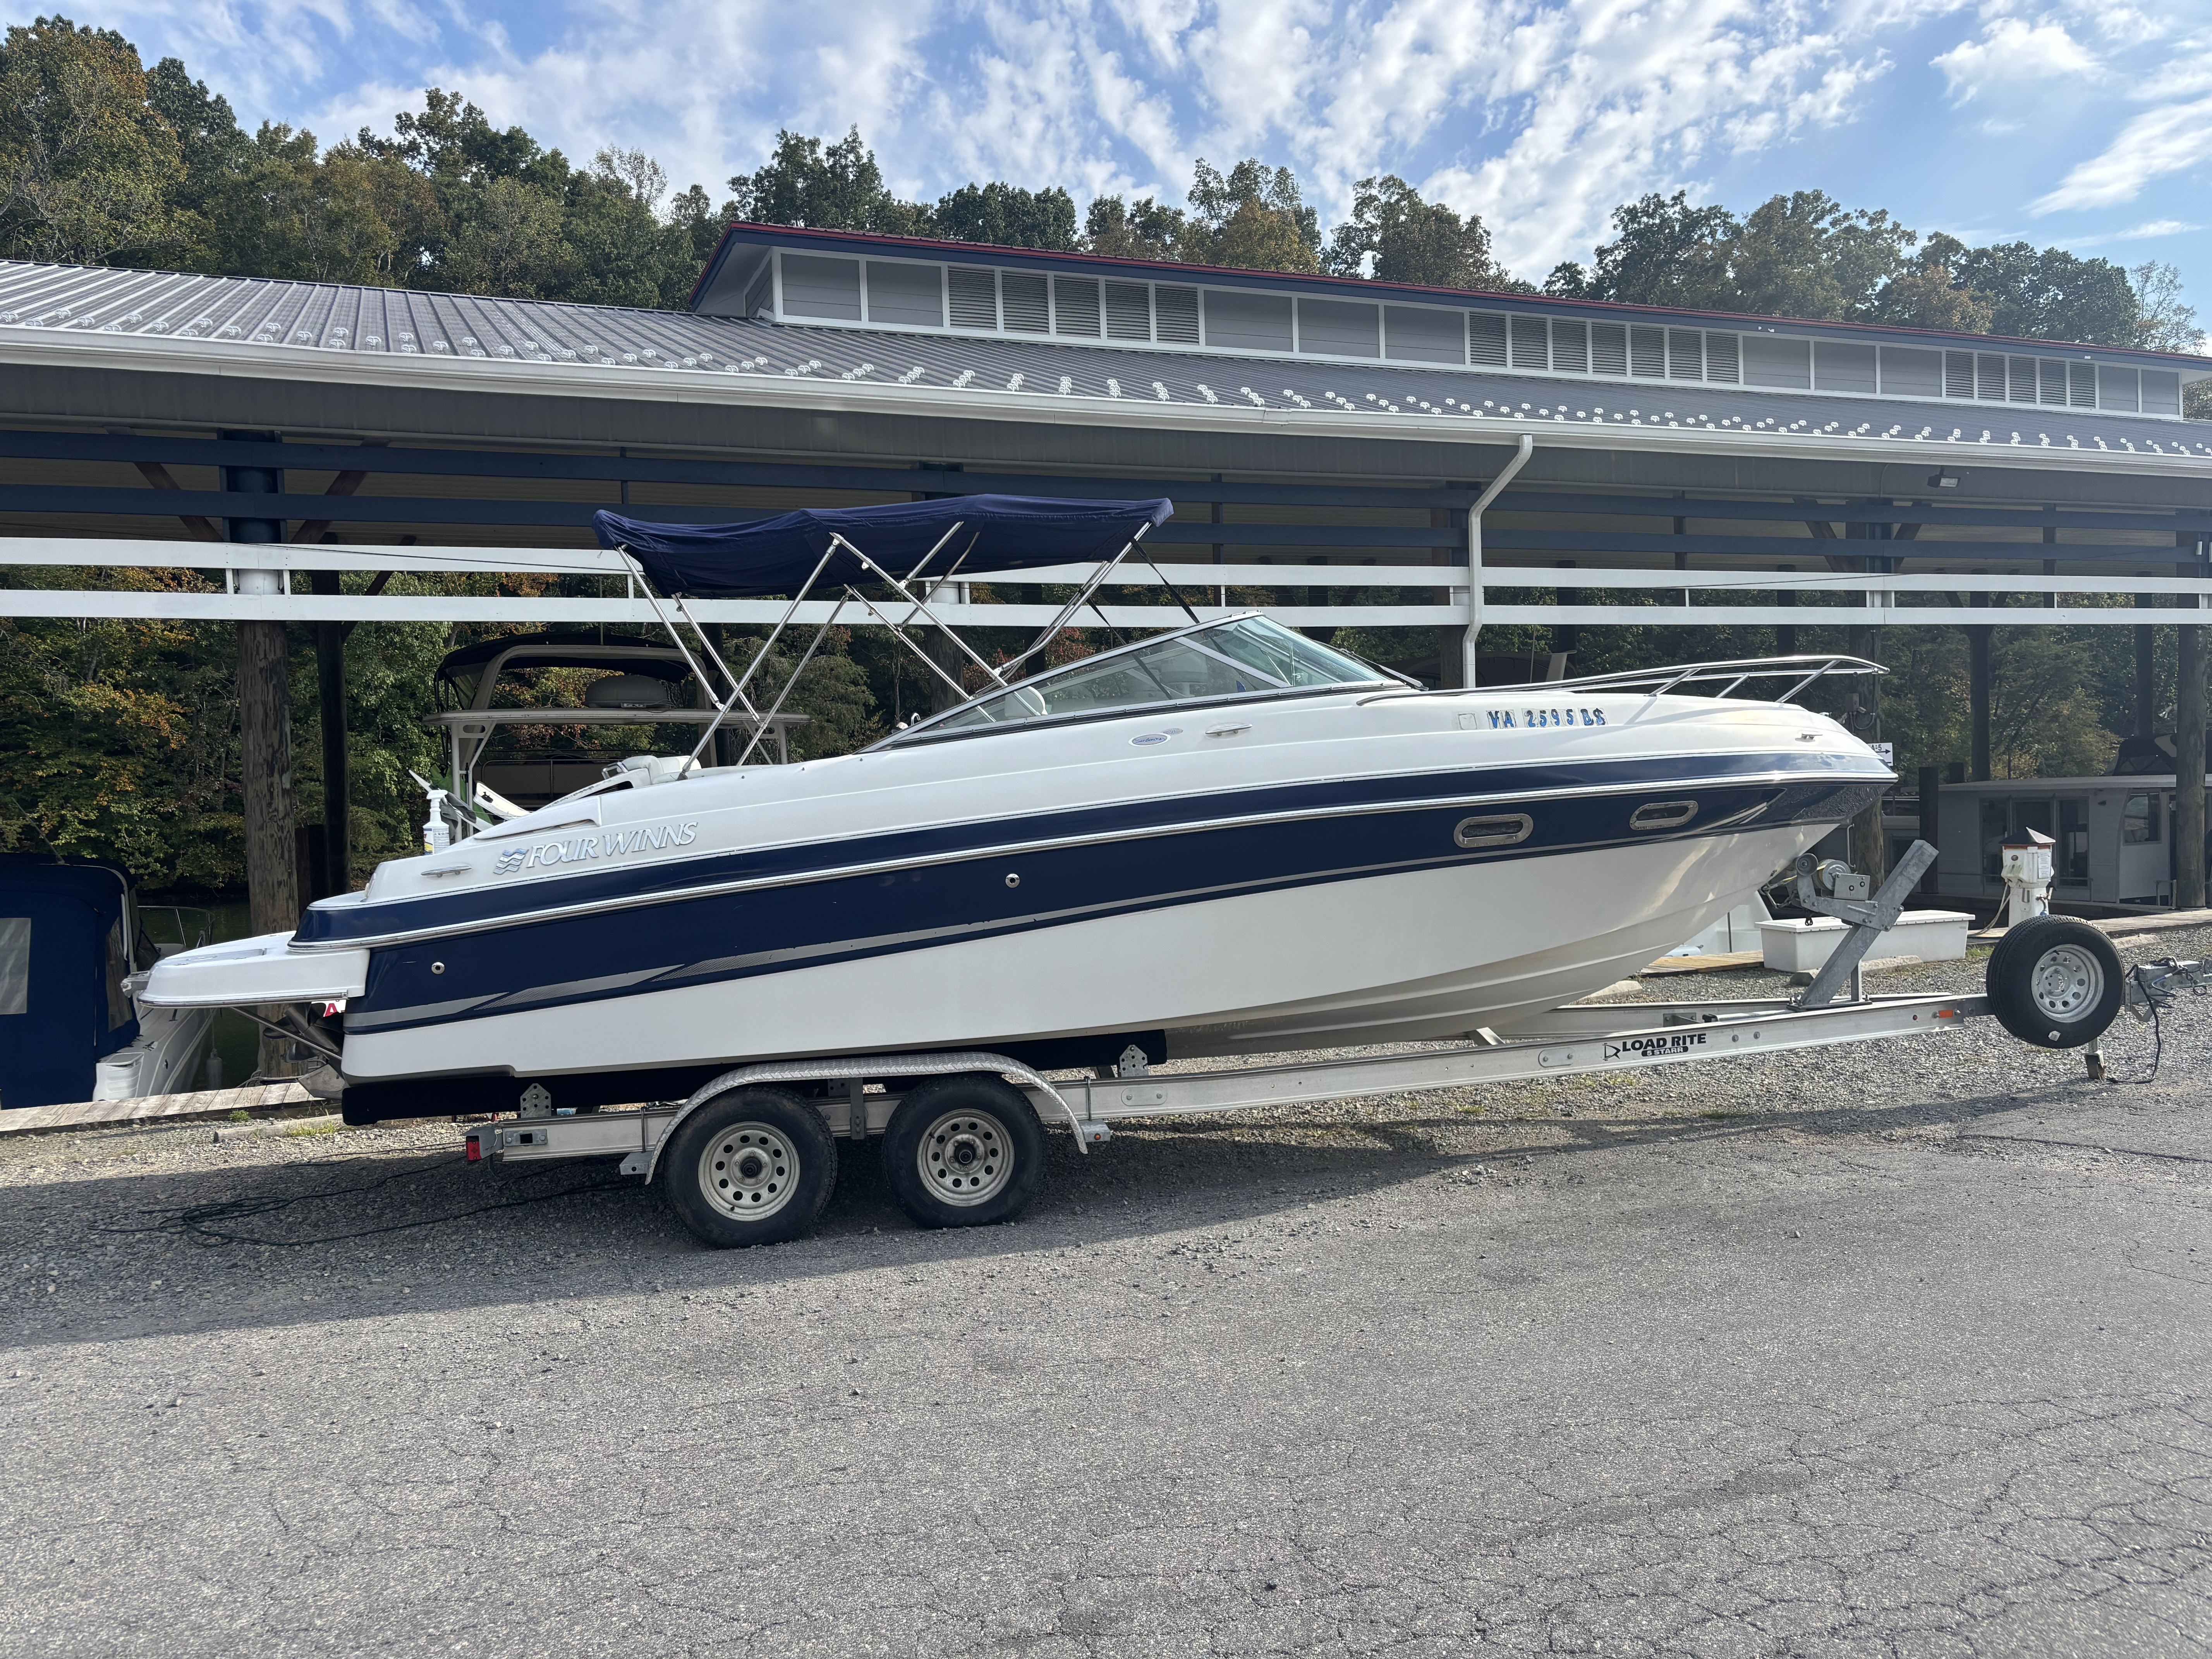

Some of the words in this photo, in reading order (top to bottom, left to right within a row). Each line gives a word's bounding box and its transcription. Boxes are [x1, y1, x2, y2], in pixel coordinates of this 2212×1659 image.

[1488, 711, 1514, 728] VA
[1525, 709, 1573, 728] 2595
[526, 837, 599, 868] FOUR
[603, 821, 698, 856] WINNS
[1622, 1037, 1667, 1052] LOAD
[1671, 1033, 1706, 1047] RITE
[1654, 1047, 1683, 1055] STARR
